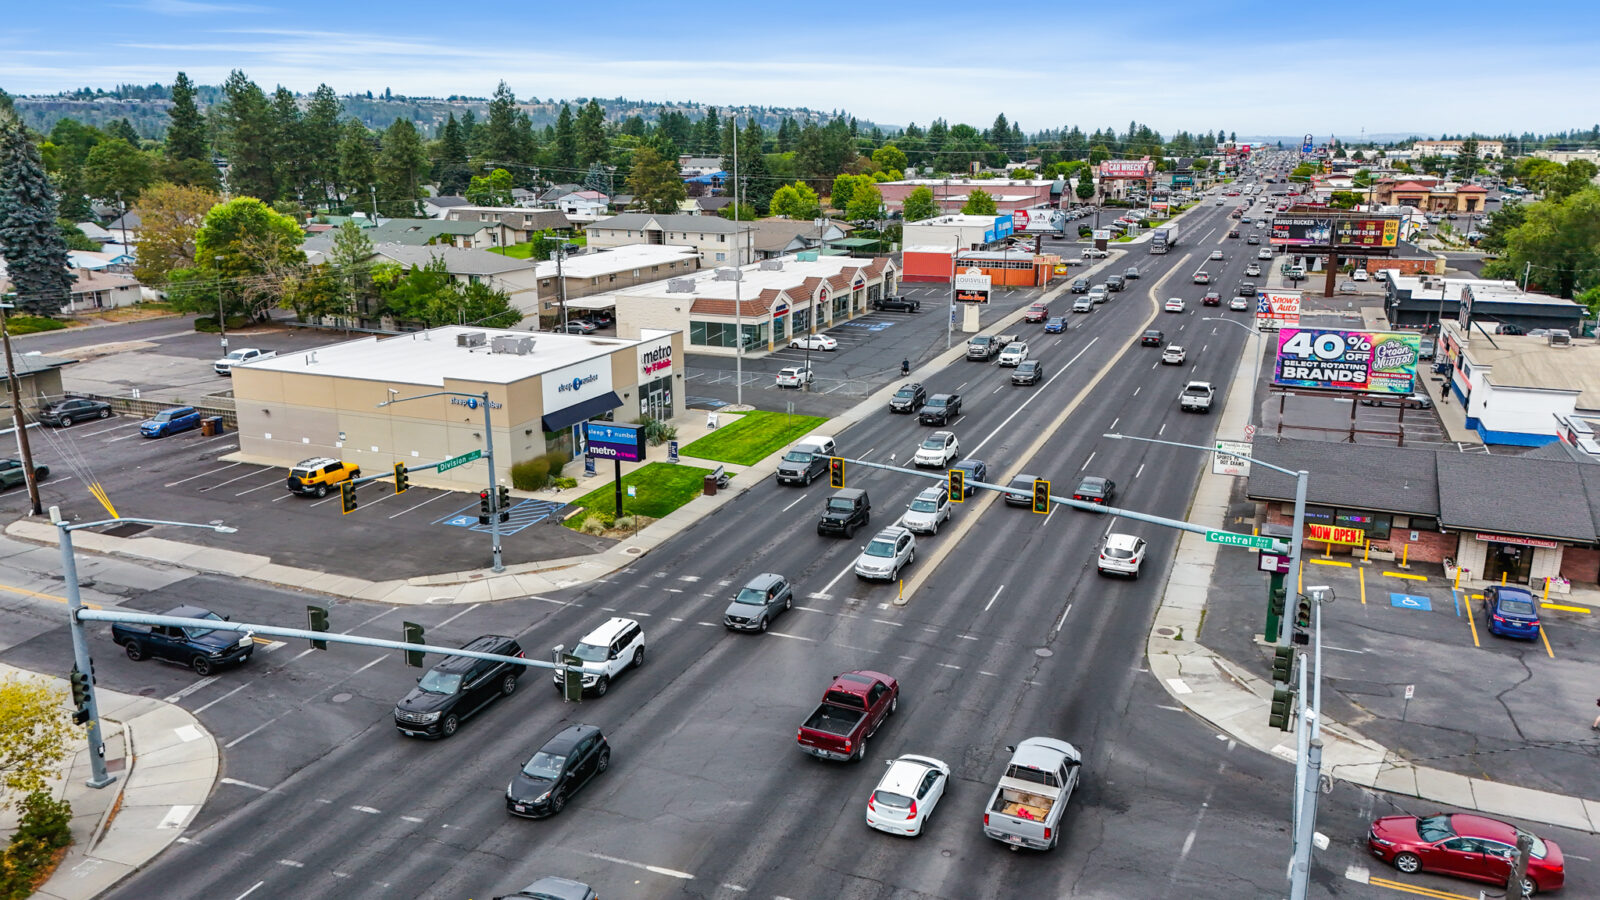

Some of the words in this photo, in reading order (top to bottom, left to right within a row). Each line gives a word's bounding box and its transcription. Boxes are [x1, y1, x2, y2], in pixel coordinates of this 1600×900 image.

[1387, 341, 1400, 349] the
[643, 345, 671, 363] metro
[1377, 345, 1409, 357] Green
[1345, 353, 1370, 361] OFF
[1283, 367, 1366, 382] BRANDS
[558, 383, 573, 393] sleep
[450, 397, 467, 407] sleep
[588, 429, 605, 437] sleep
[614, 431, 637, 440] number
[590, 446, 617, 456] metro
[440, 457, 467, 471] Division
[1210, 533, 1252, 546] Central
[1309, 524, 1331, 541] NOW
[1333, 529, 1361, 544] OPEN!
